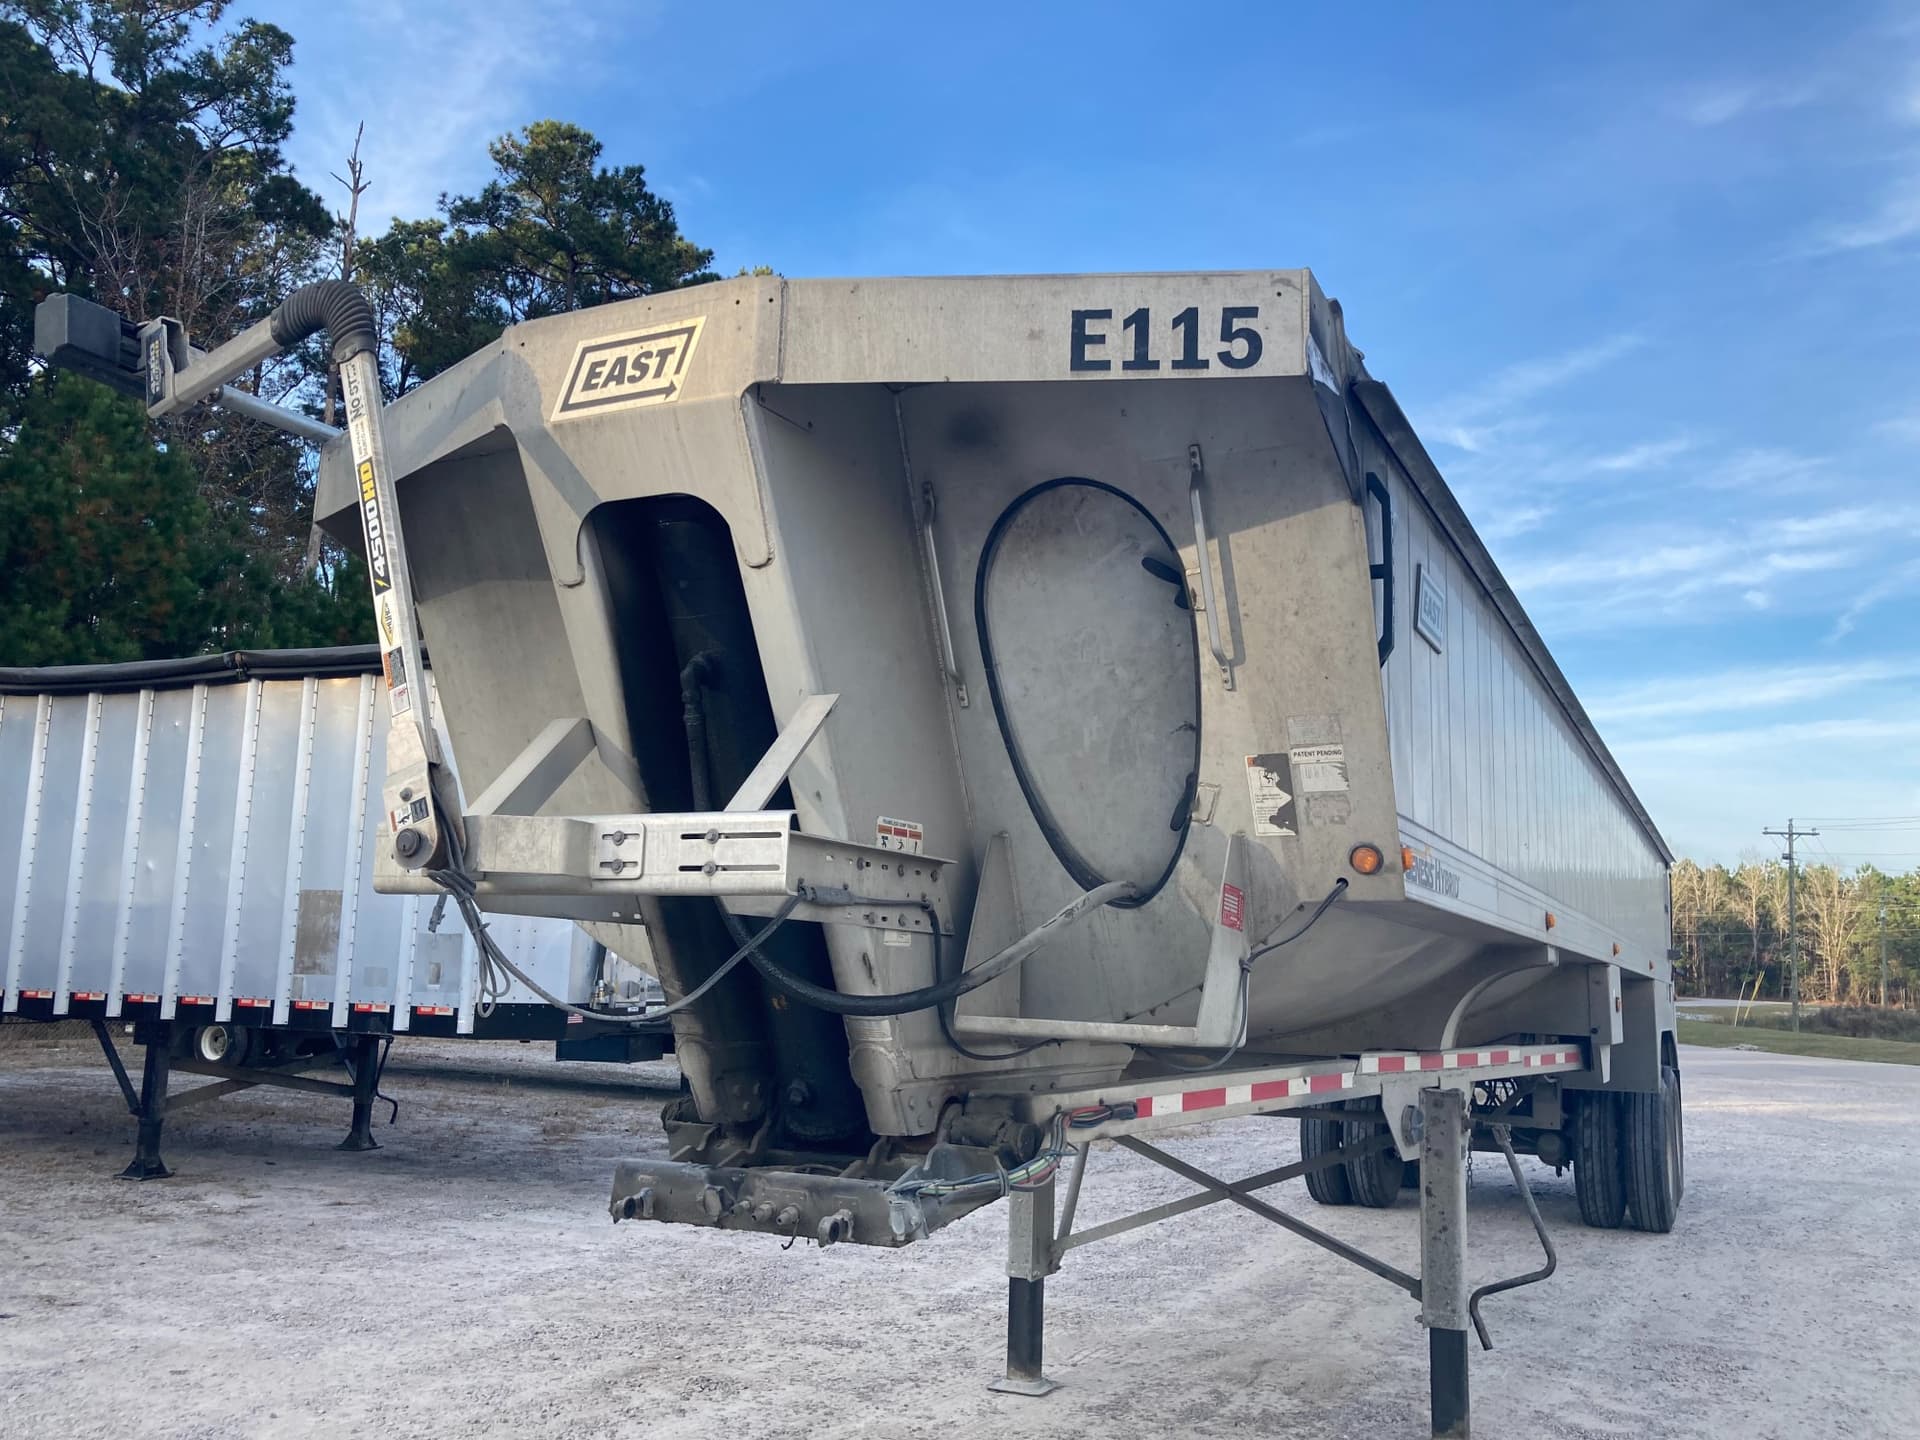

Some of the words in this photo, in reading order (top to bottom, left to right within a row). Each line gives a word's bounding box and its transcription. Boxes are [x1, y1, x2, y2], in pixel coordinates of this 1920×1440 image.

[1070, 306, 1263, 371] E115
[581, 346, 677, 392] EAST
[1316, 749, 1343, 757] PENDING
